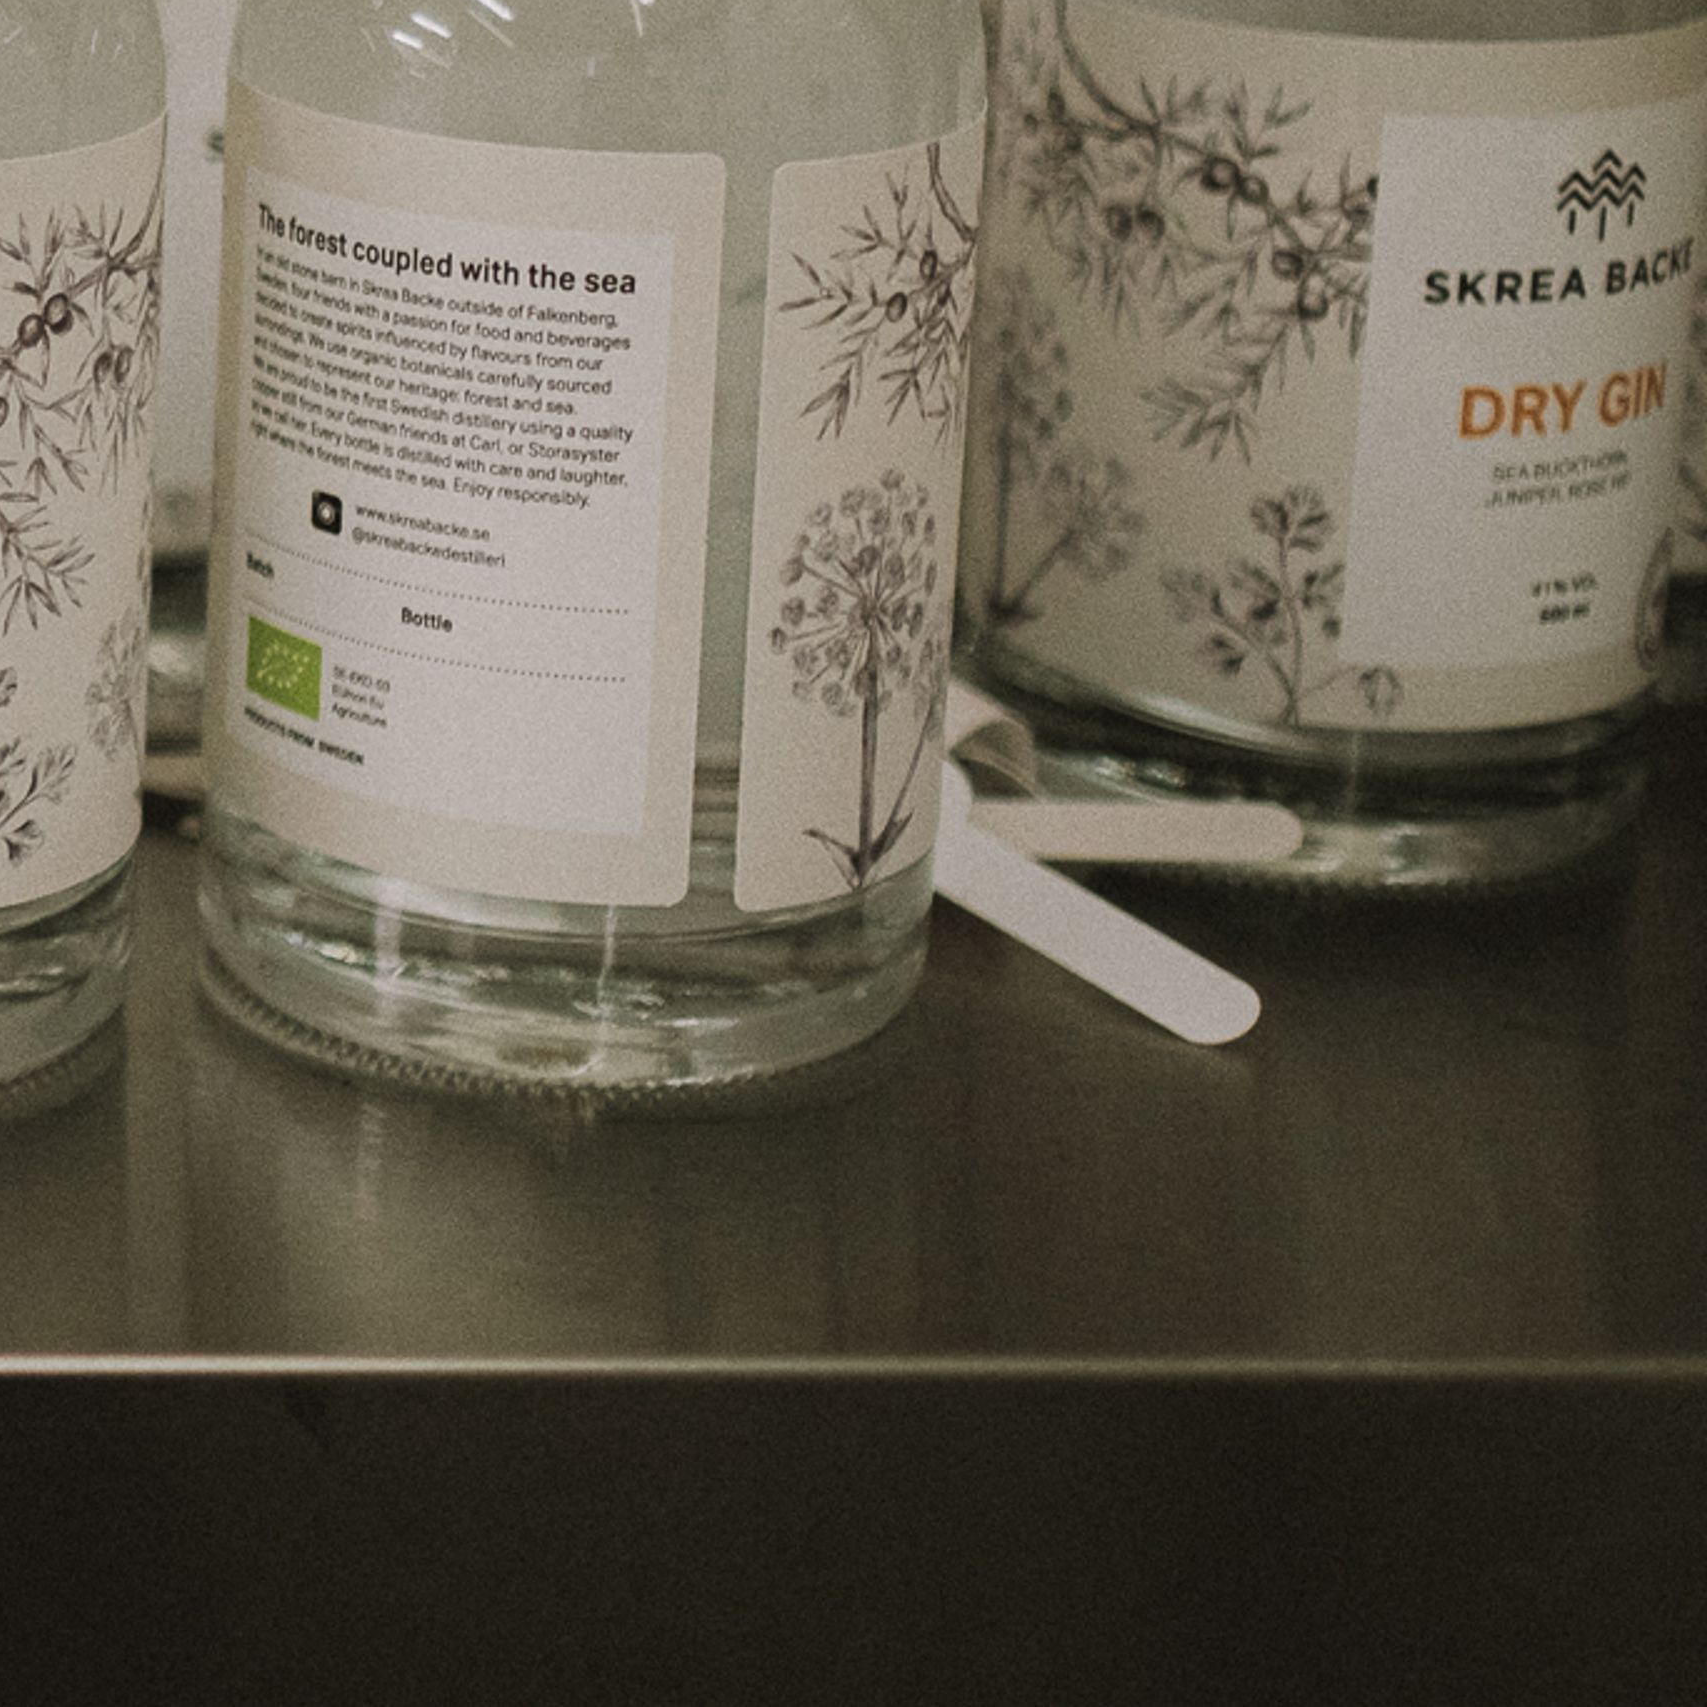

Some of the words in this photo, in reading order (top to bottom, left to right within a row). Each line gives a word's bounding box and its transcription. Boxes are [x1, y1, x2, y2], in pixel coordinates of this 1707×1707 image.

[258, 201, 284, 237] The
[289, 216, 346, 257] forest
[352, 241, 452, 277] coupled
[460, 257, 519, 286] with
[528, 263, 575, 291] the
[584, 272, 635, 294] sea
[401, 287, 443, 309] Backe
[447, 299, 503, 317] outside
[507, 304, 523, 318] of
[1424, 268, 1587, 306] SKREA
[375, 330, 446, 354] influenced
[449, 342, 467, 360] by
[471, 344, 531, 365] flavours
[536, 351, 572, 368] from
[576, 358, 603, 370] our
[382, 310, 389, 322] a
[393, 311, 447, 330] passion
[451, 319, 470, 335] for
[475, 322, 510, 340] food
[514, 330, 543, 344] and
[546, 331, 630, 352] beverages
[400, 356, 473, 381] botanicals
[477, 371, 542, 392] carefully
[547, 378, 612, 395] sourced
[464, 389, 508, 408] forest
[512, 397, 542, 412] and
[1459, 381, 1584, 439] DRY
[1596, 359, 1667, 427] GIN
[391, 398, 448, 421] Swedish
[452, 411, 516, 434] distillery
[519, 422, 562, 440] using
[566, 426, 575, 437] a
[579, 425, 633, 444] quality
[399, 422, 447, 445] friends
[451, 434, 465, 447] at
[507, 443, 523, 454] or
[528, 441, 620, 464] Storasyster
[397, 446, 450, 468] distilled
[454, 458, 485, 472] with
[489, 463, 522, 478] care
[526, 467, 556, 481] and
[560, 468, 627, 487] laughter,
[453, 476, 494, 500] Enjoy
[401, 607, 453, 633] Bottle
